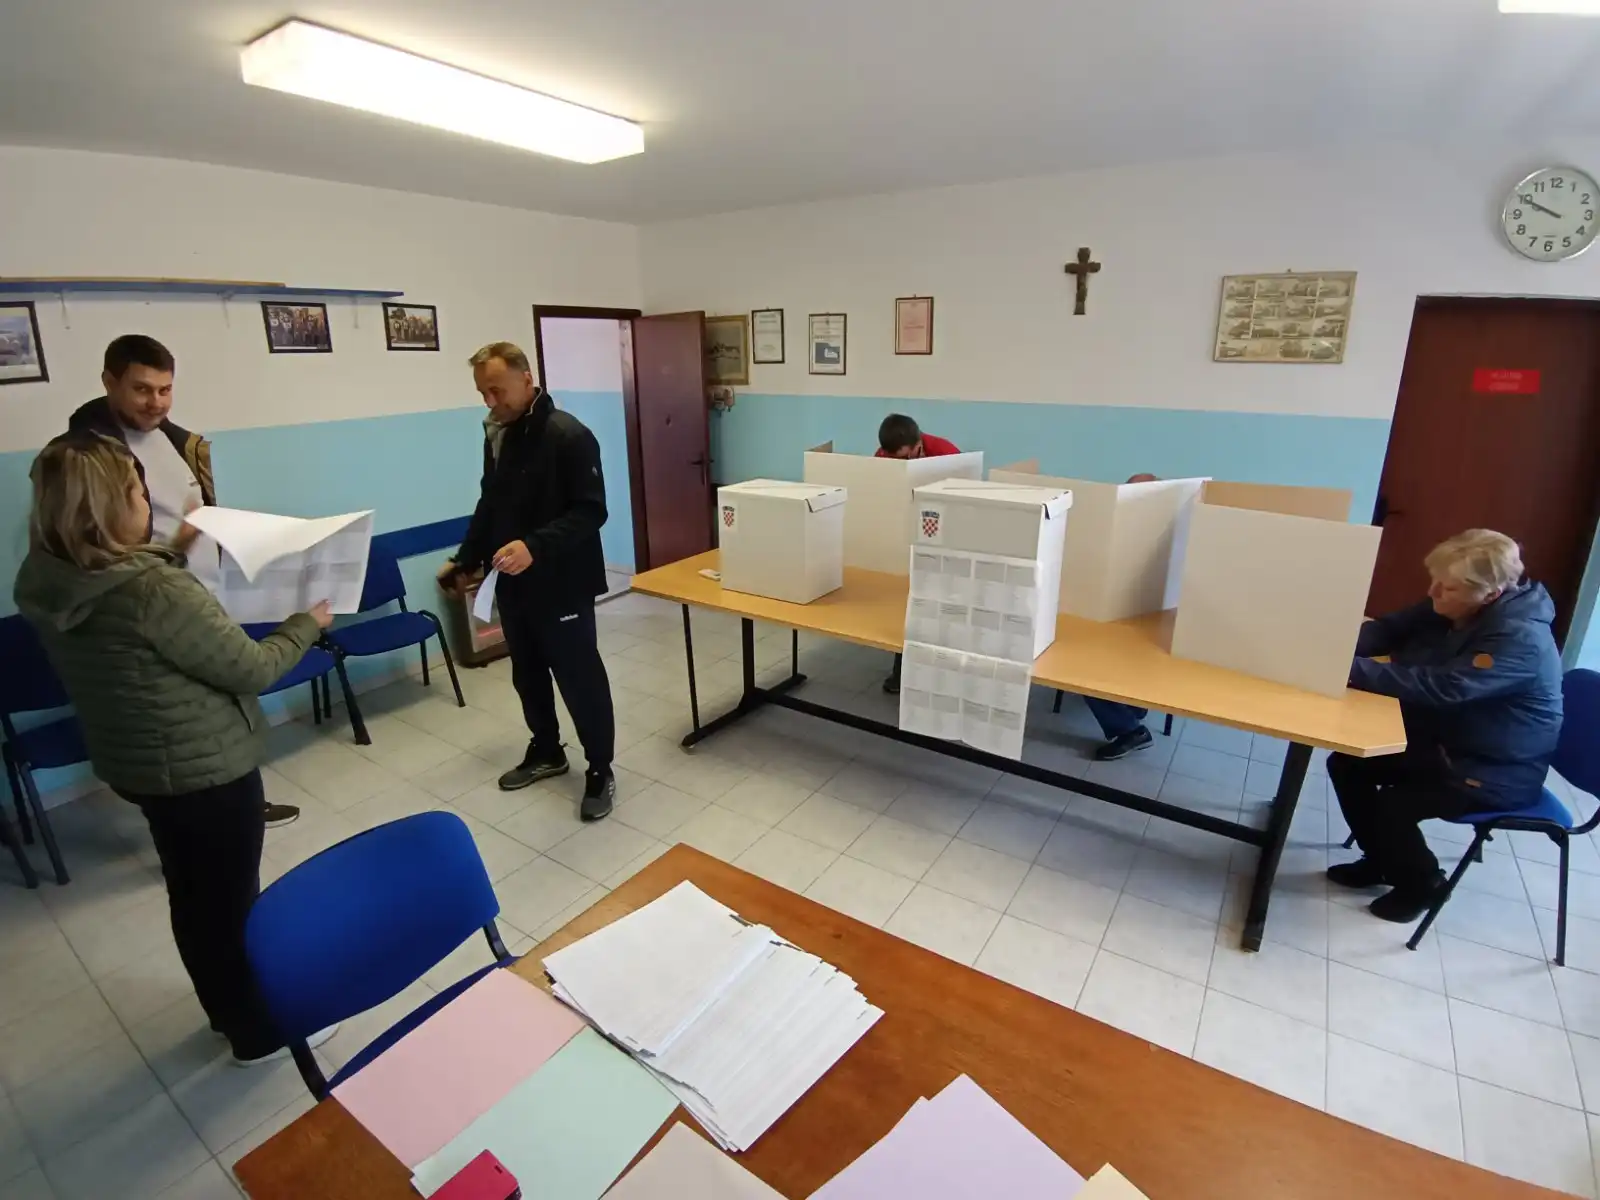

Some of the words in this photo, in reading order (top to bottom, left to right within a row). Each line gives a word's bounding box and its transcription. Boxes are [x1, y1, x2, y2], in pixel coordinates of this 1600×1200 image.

[1533, 182, 1545, 193] 11
[1550, 177, 1564, 189] 12
[1570, 182, 1576, 193] 1
[1517, 194, 1533, 205] 10
[1581, 193, 1590, 205] 2
[1513, 209, 1522, 220] 9
[1584, 209, 1593, 221] 3
[1516, 224, 1526, 235] 8
[1575, 225, 1586, 236] 4
[1529, 236, 1538, 247] 7
[1544, 241, 1553, 252] 6
[1562, 236, 1571, 248] 5
